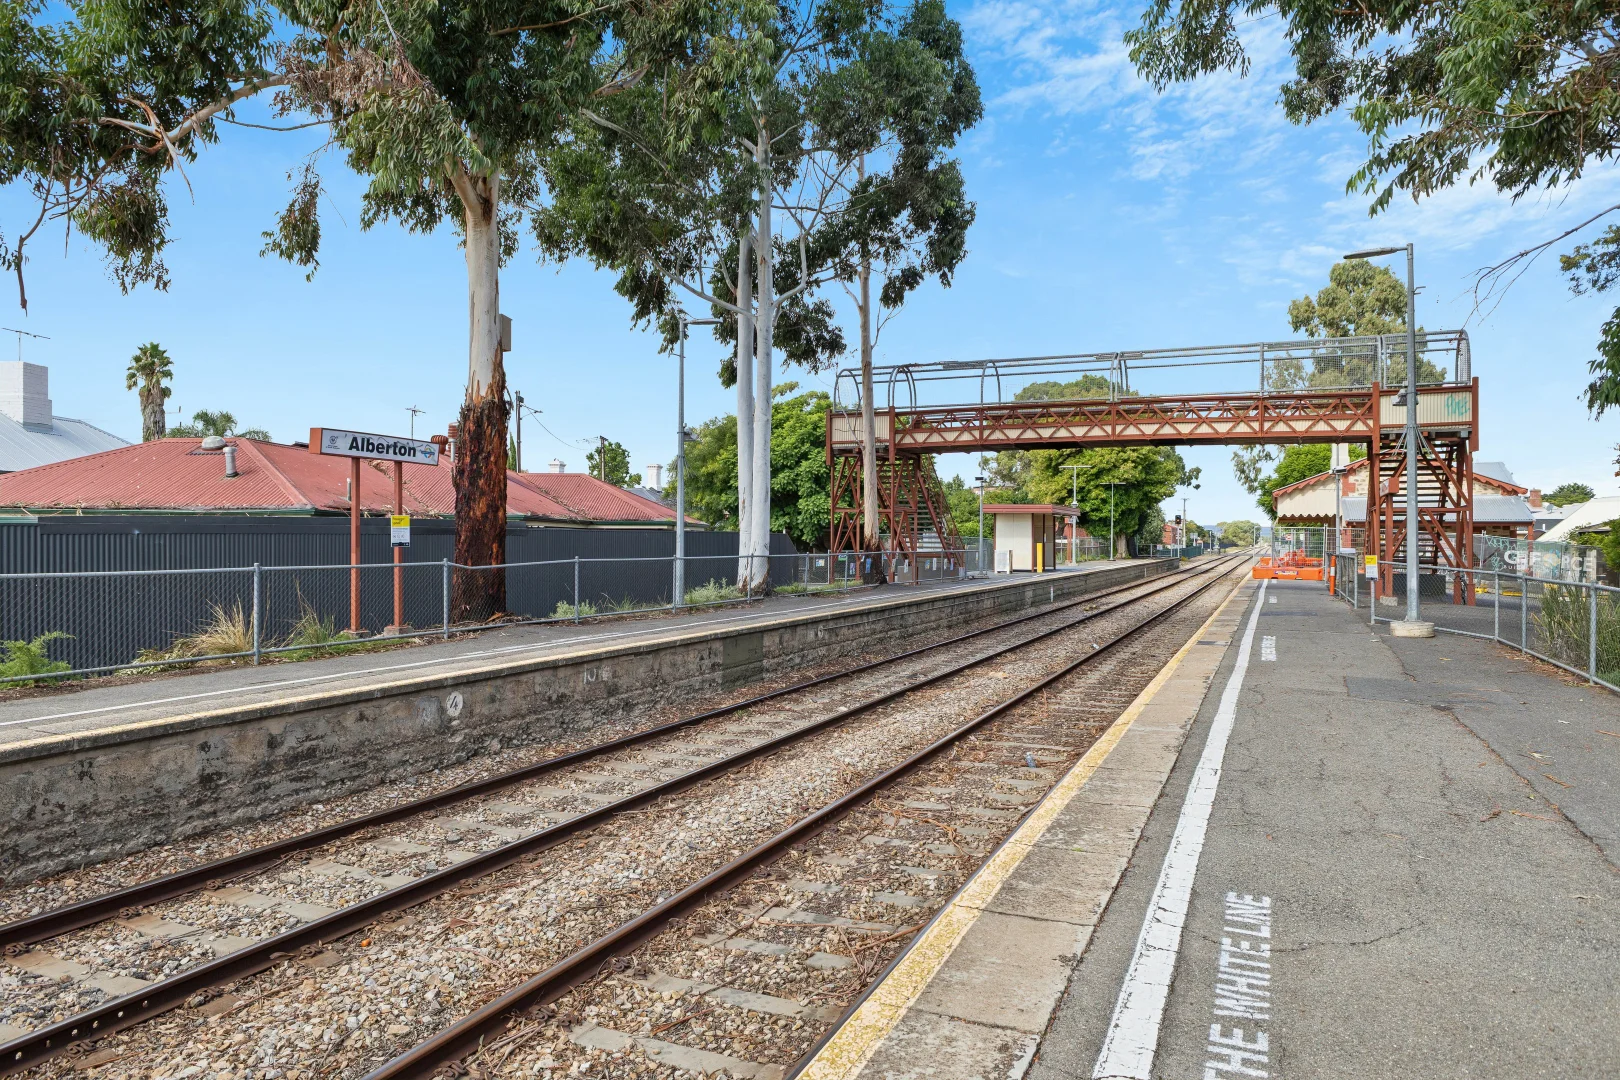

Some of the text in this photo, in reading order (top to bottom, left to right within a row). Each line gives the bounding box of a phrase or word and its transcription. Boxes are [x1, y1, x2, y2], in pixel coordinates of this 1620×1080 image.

[348, 436, 417, 457] Alberton
[1224, 891, 1271, 938] LINE
[1213, 937, 1271, 1020] WHITE
